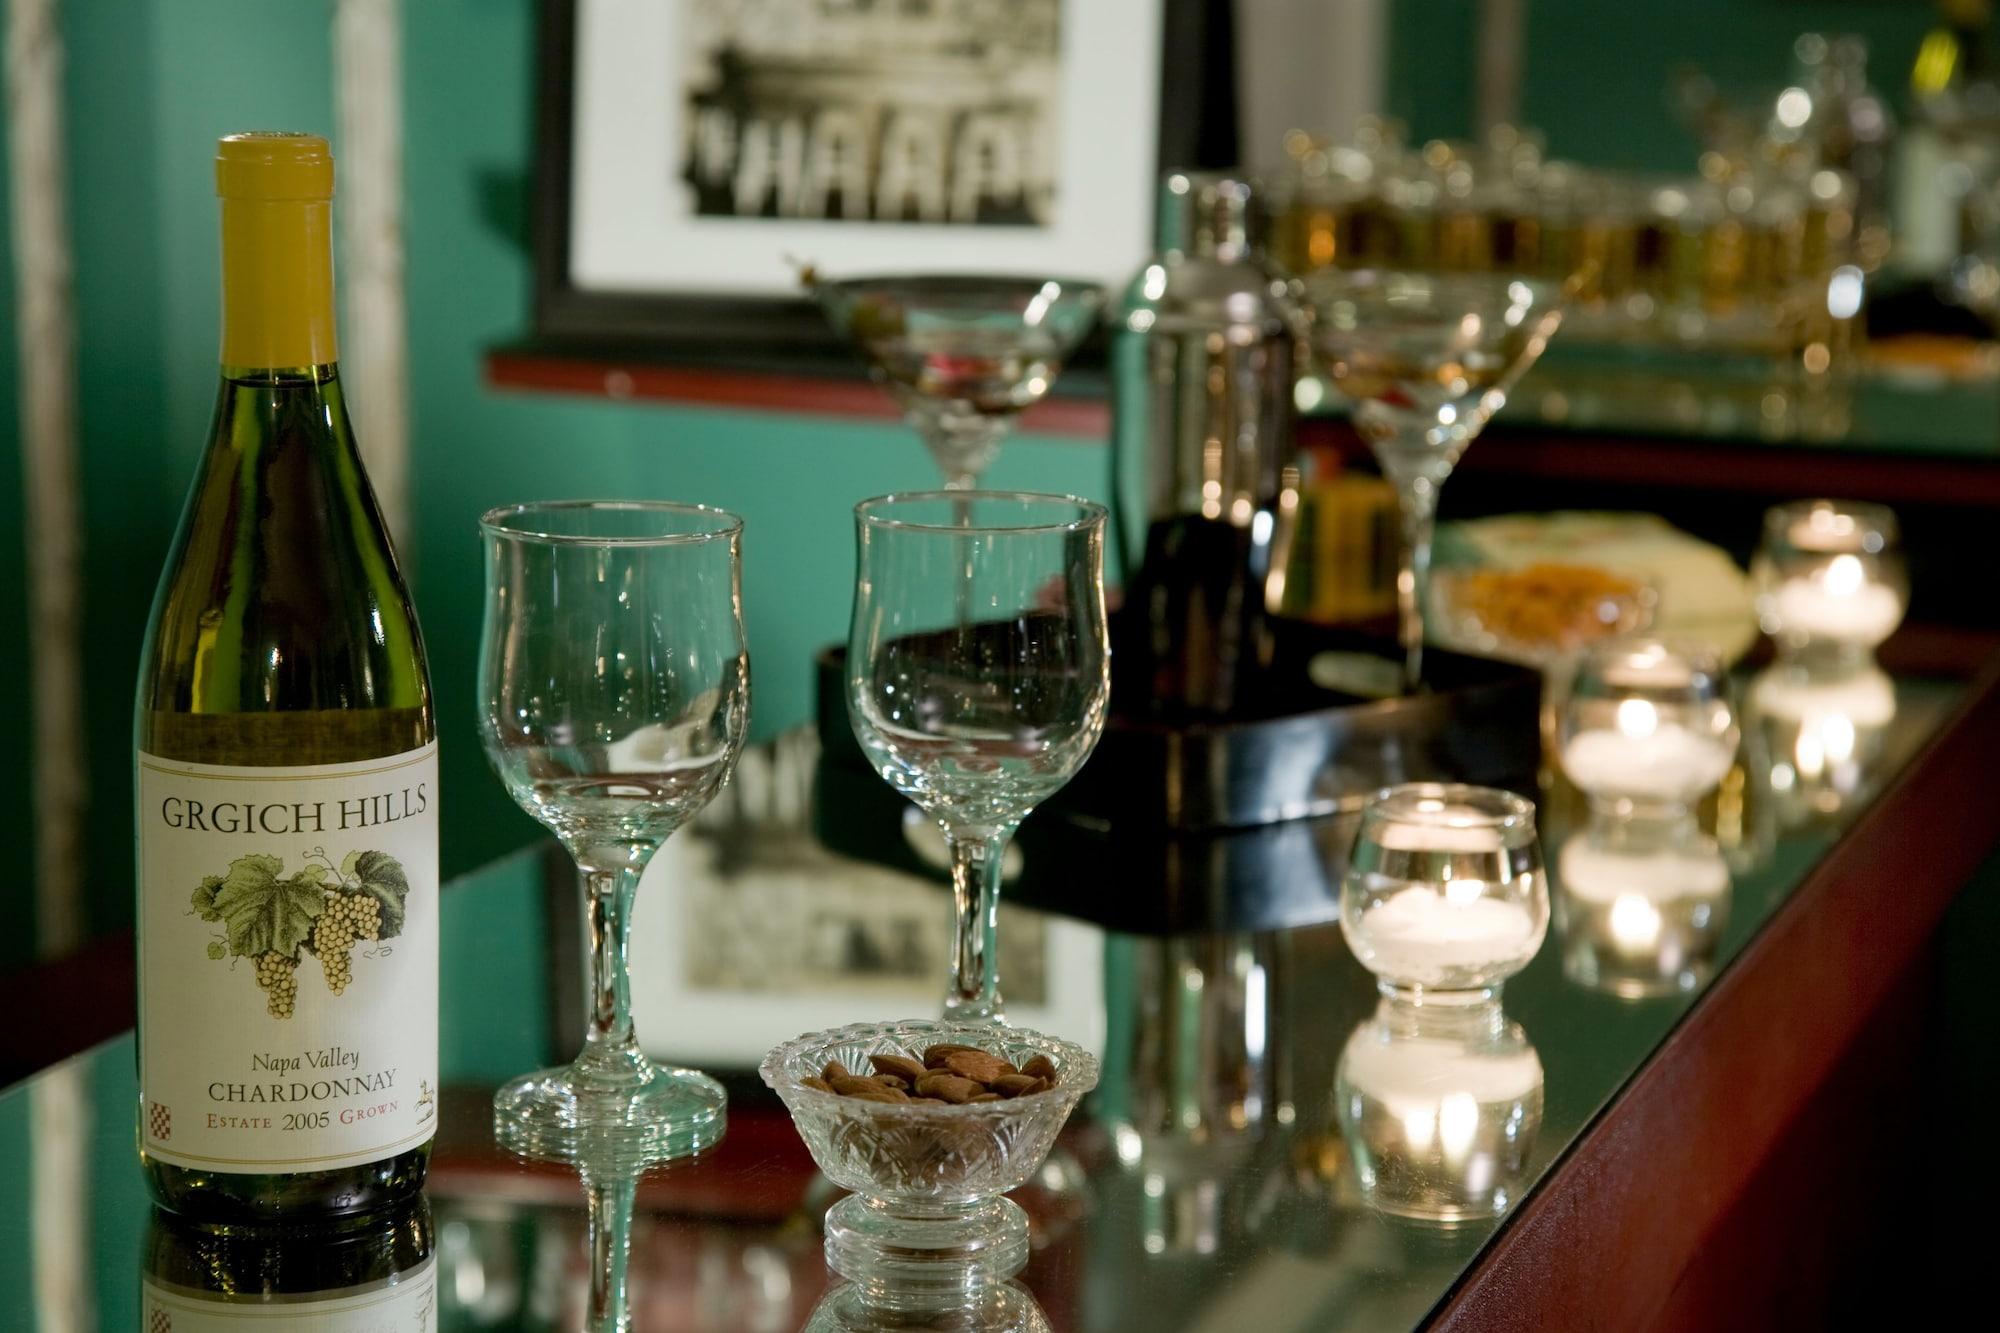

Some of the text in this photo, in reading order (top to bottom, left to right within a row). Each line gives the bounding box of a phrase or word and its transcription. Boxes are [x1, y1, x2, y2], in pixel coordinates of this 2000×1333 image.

[162, 783, 427, 834] GRGICH HILLS
[252, 1047, 360, 1077] Napa Valley
[208, 1069, 398, 1103] CHARDONNAY
[283, 1111, 330, 1130] 2005
